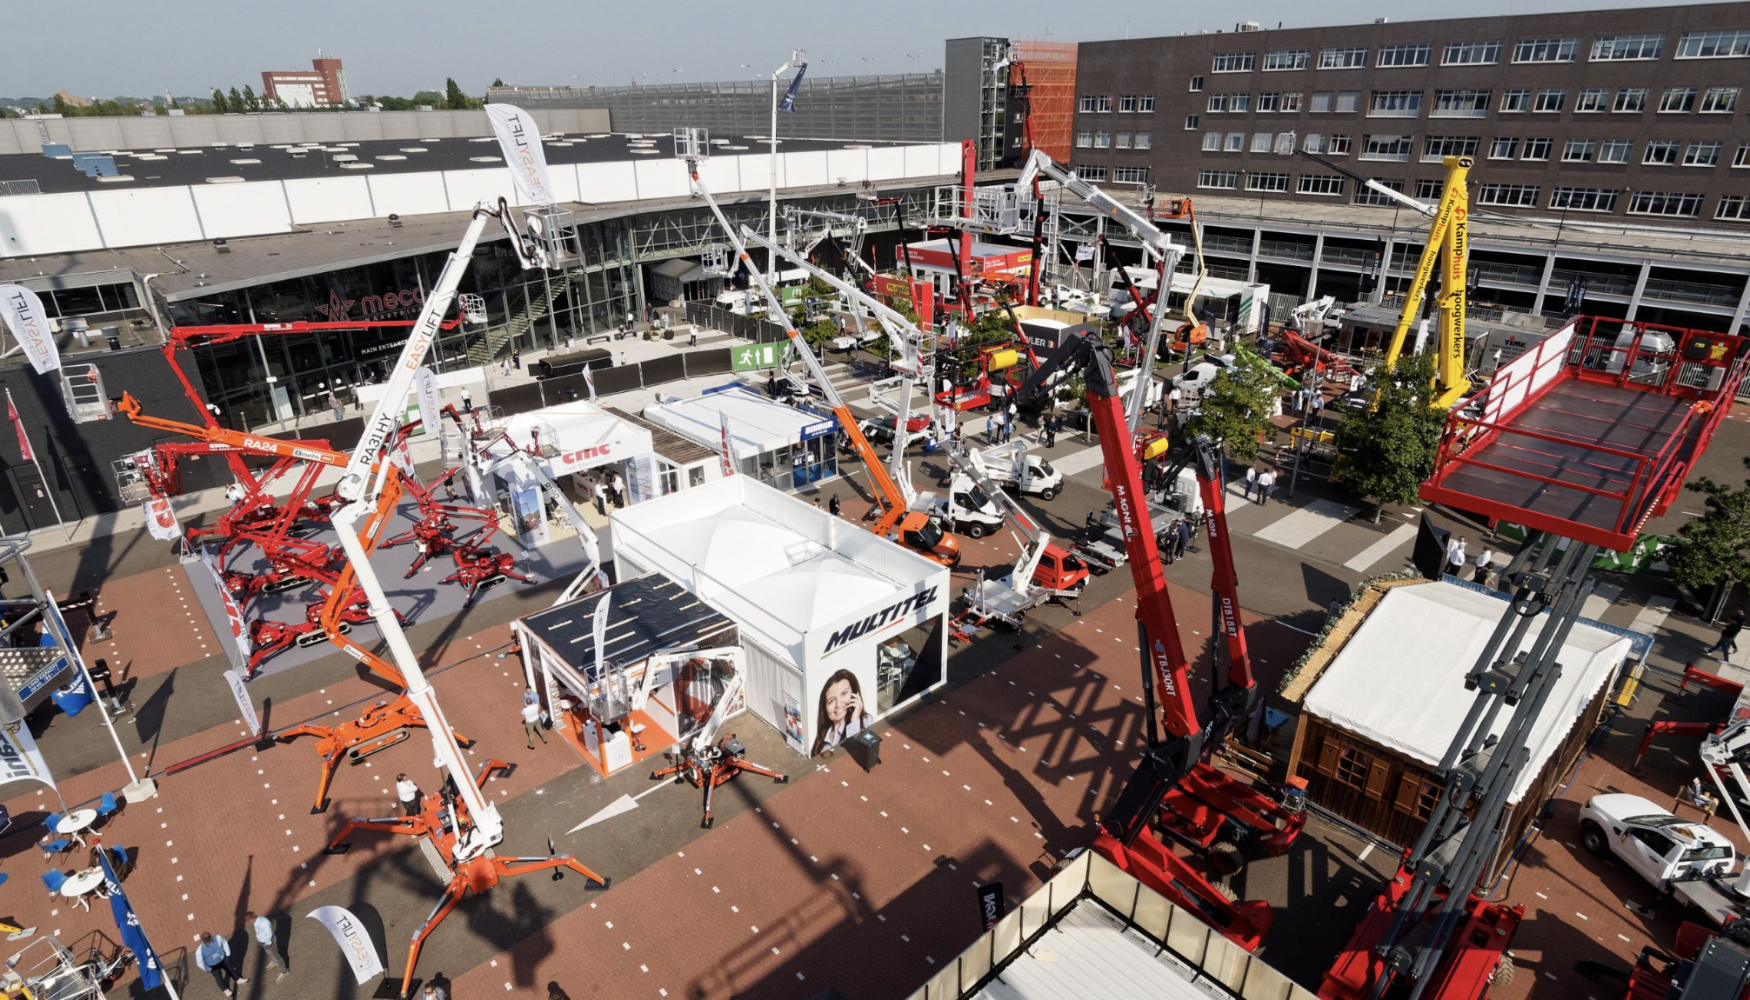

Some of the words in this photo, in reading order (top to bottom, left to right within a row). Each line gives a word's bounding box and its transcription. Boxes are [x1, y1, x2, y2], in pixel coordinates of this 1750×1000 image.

[1433, 198, 1455, 242] Kamphuis
[1452, 222, 1466, 280] Kamphuis
[405, 308, 442, 371] EASYLIFT
[1452, 289, 1466, 359] hoogwerkers
[361, 345, 378, 355] MAIN
[243, 438, 277, 453] RA24
[823, 585, 938, 653] MULTITEL
[1222, 598, 1237, 638] DTB18RT
